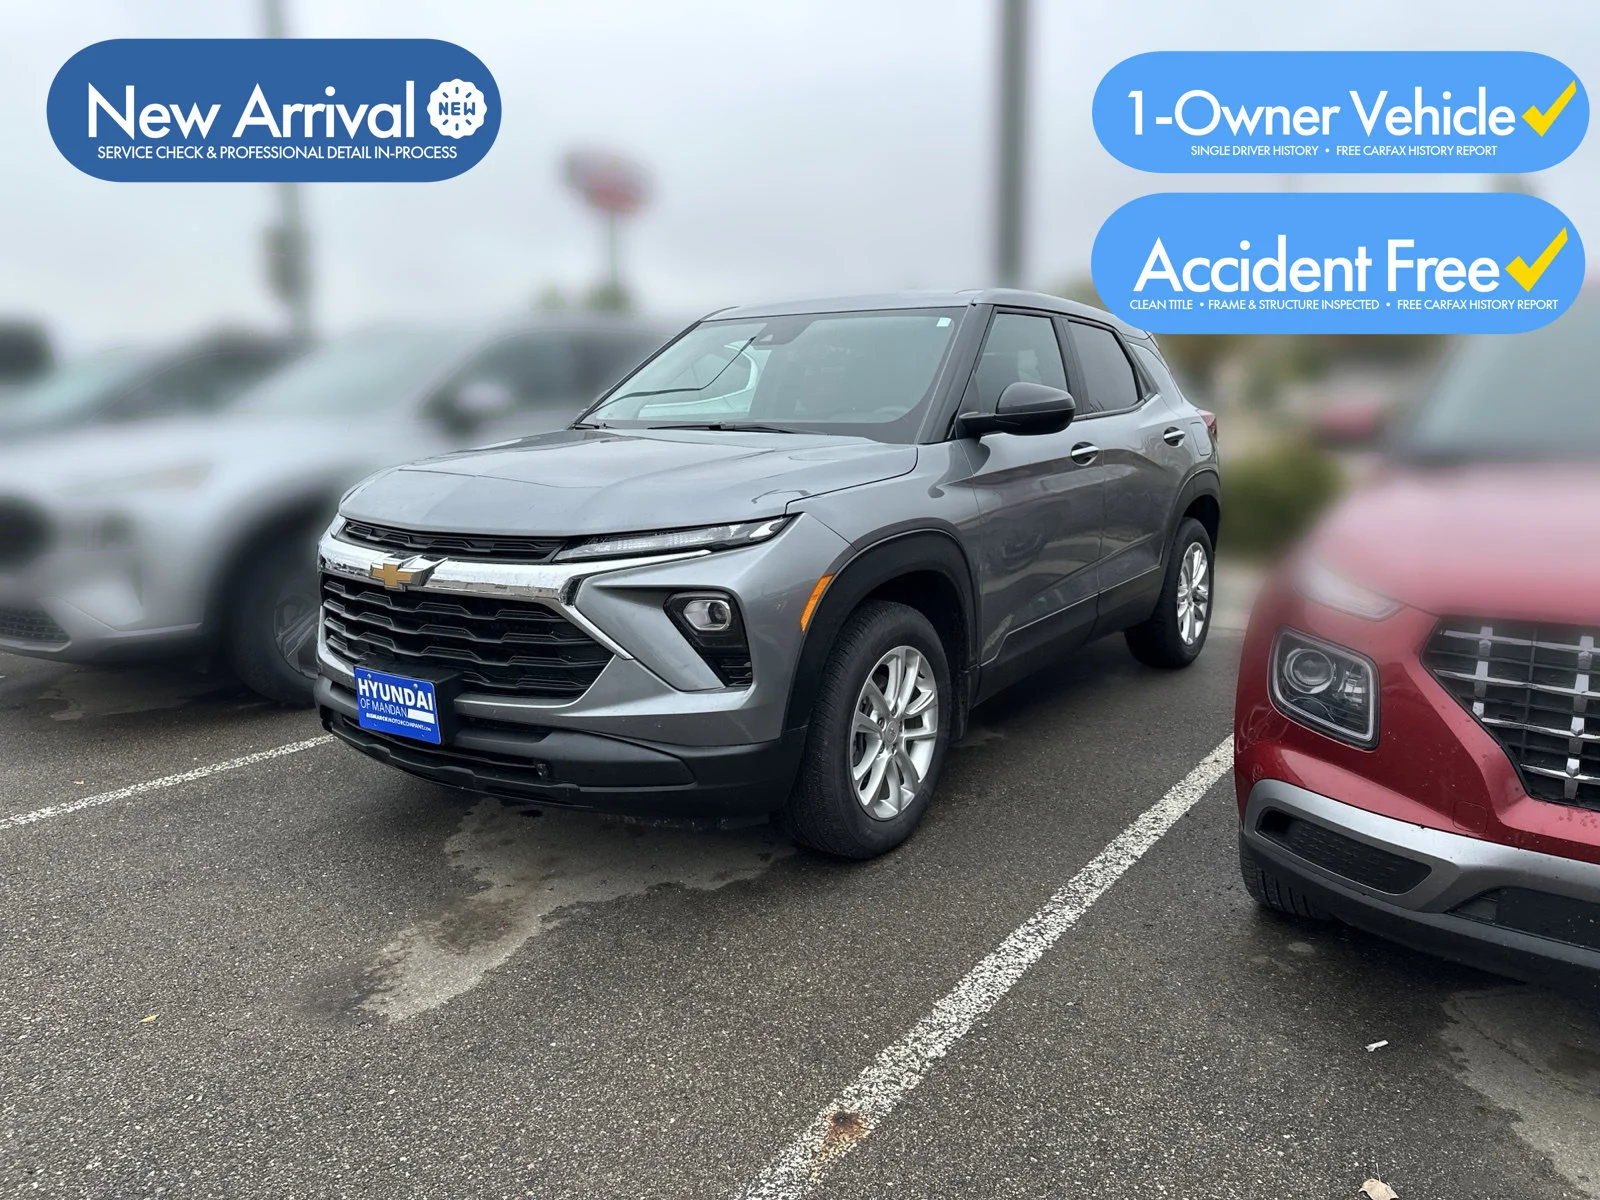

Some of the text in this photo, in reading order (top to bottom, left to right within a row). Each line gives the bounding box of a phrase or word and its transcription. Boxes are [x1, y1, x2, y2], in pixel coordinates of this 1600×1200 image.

[357, 677, 434, 711] HYUNDAI
[360, 697, 408, 718] OF MANDAN
